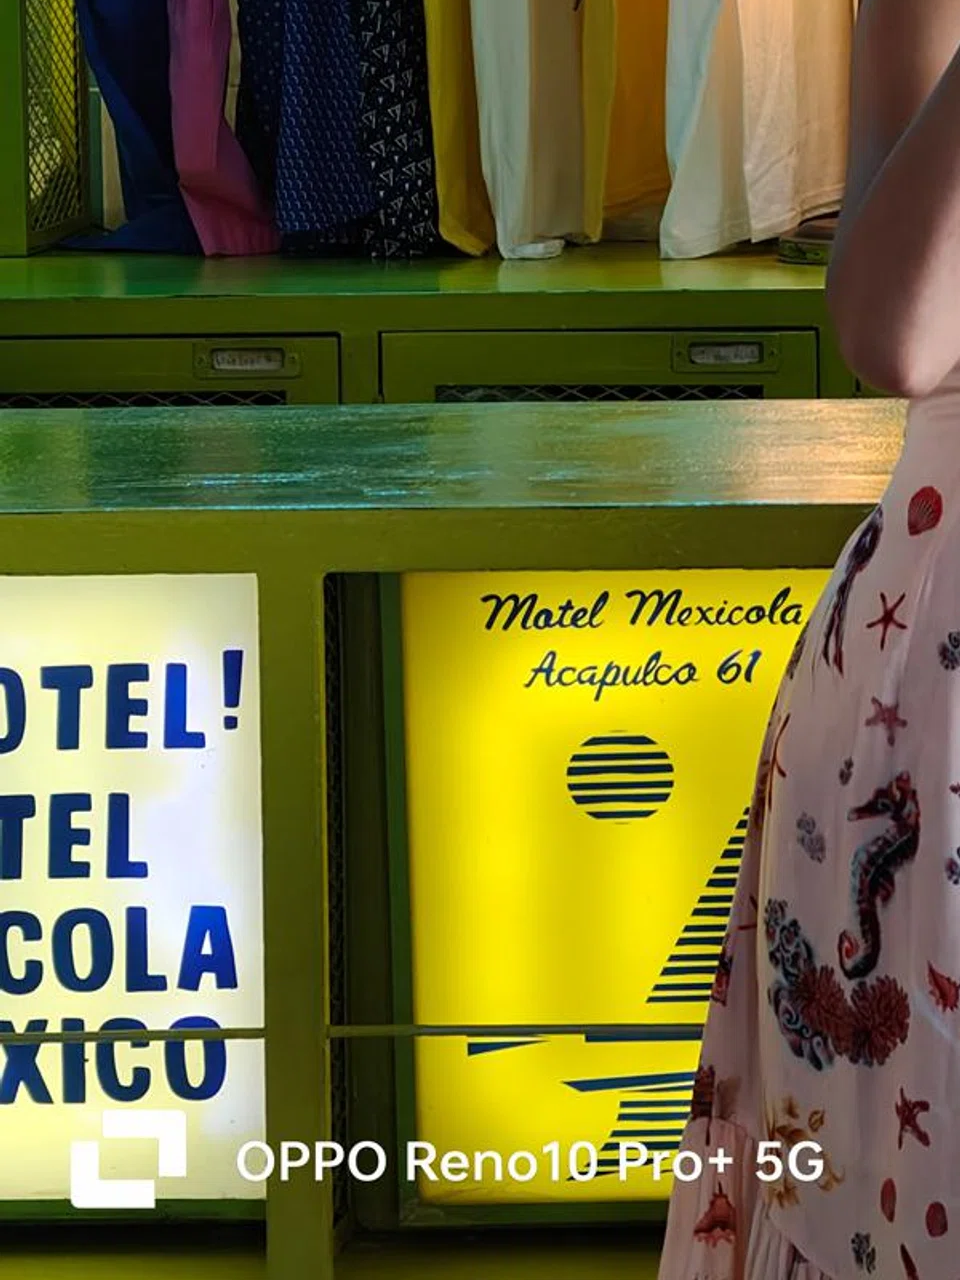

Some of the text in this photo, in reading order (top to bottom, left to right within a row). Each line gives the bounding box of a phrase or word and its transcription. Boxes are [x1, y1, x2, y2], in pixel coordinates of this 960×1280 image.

[481, 586, 802, 631] Motel Mexicola
[524, 649, 762, 701] Acapulco 61
